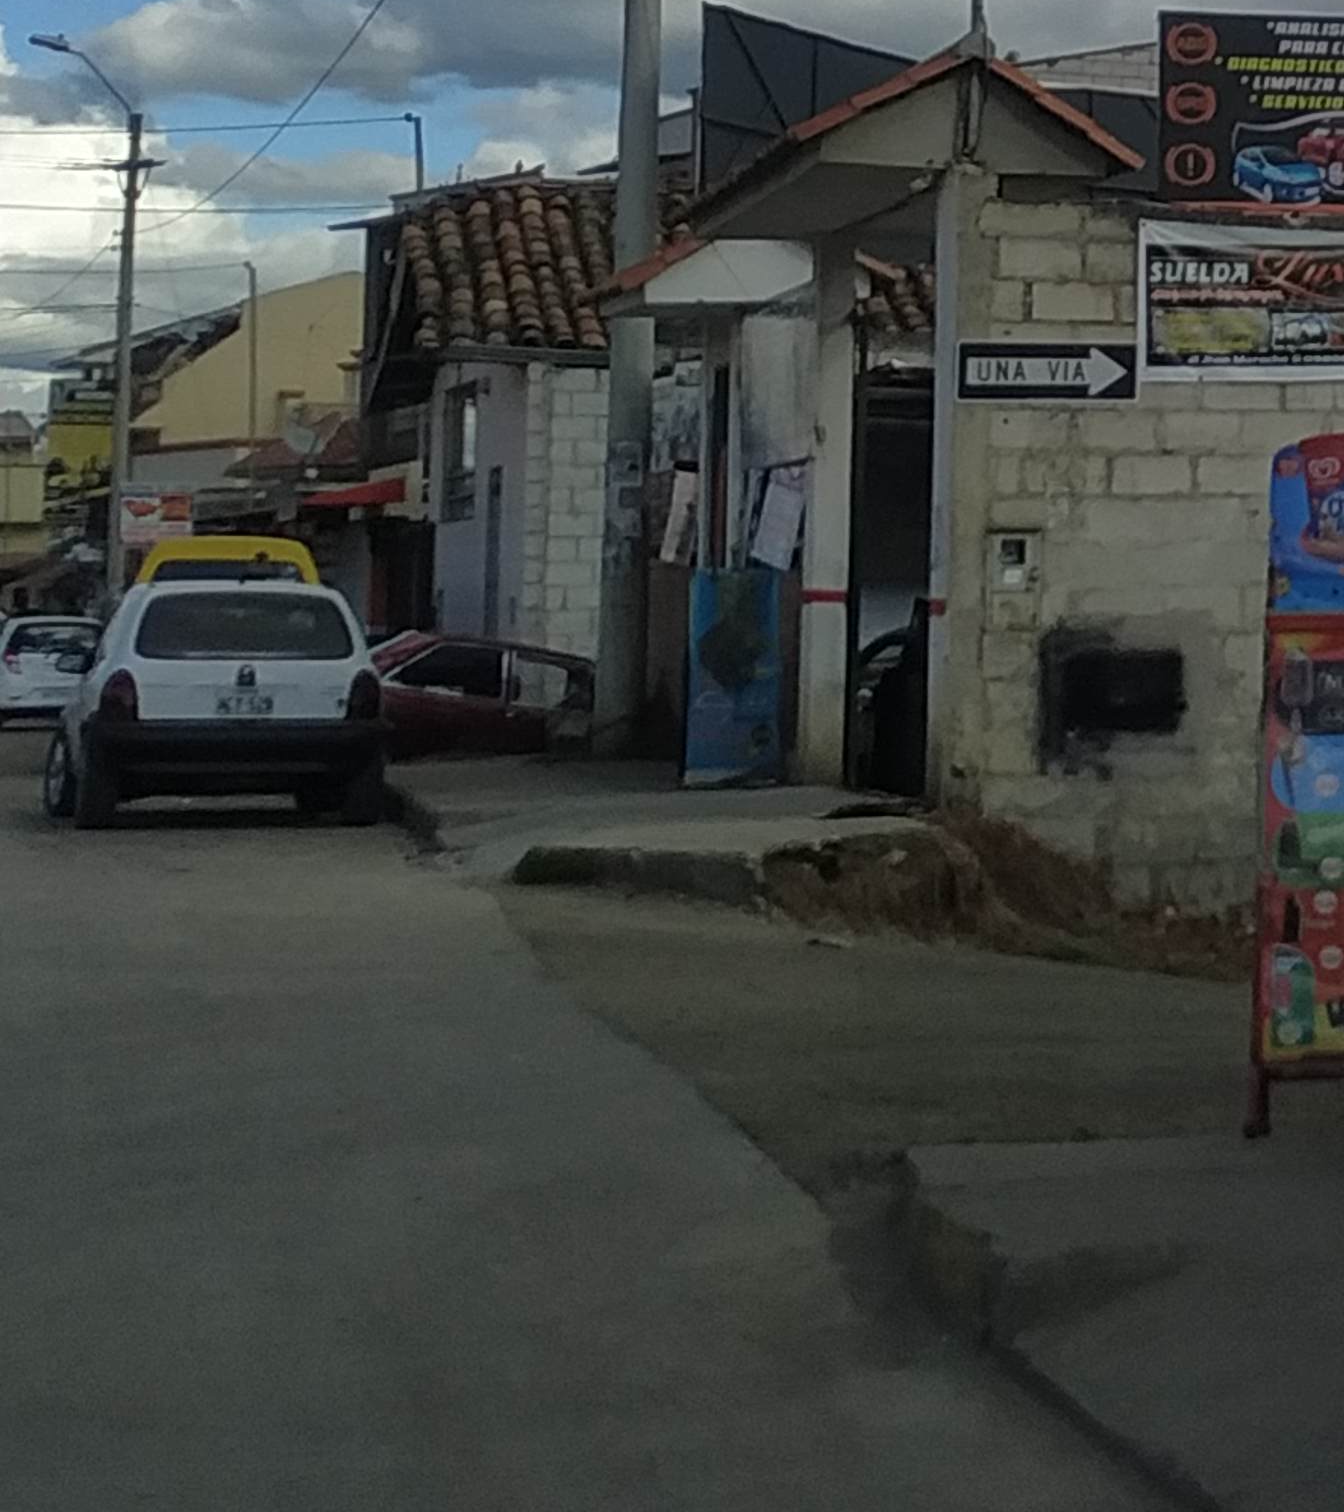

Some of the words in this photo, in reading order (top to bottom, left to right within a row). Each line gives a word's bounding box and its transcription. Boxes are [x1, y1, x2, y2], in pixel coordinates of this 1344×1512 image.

[1278, 39, 1329, 56] PARA
[1252, 75, 1336, 92] LIMPIEZA
[1261, 94, 1344, 110] SERVICIO
[1149, 261, 1249, 283] SUELDA
[977, 360, 1026, 381] UNA
[1048, 360, 1086, 381] VIA
